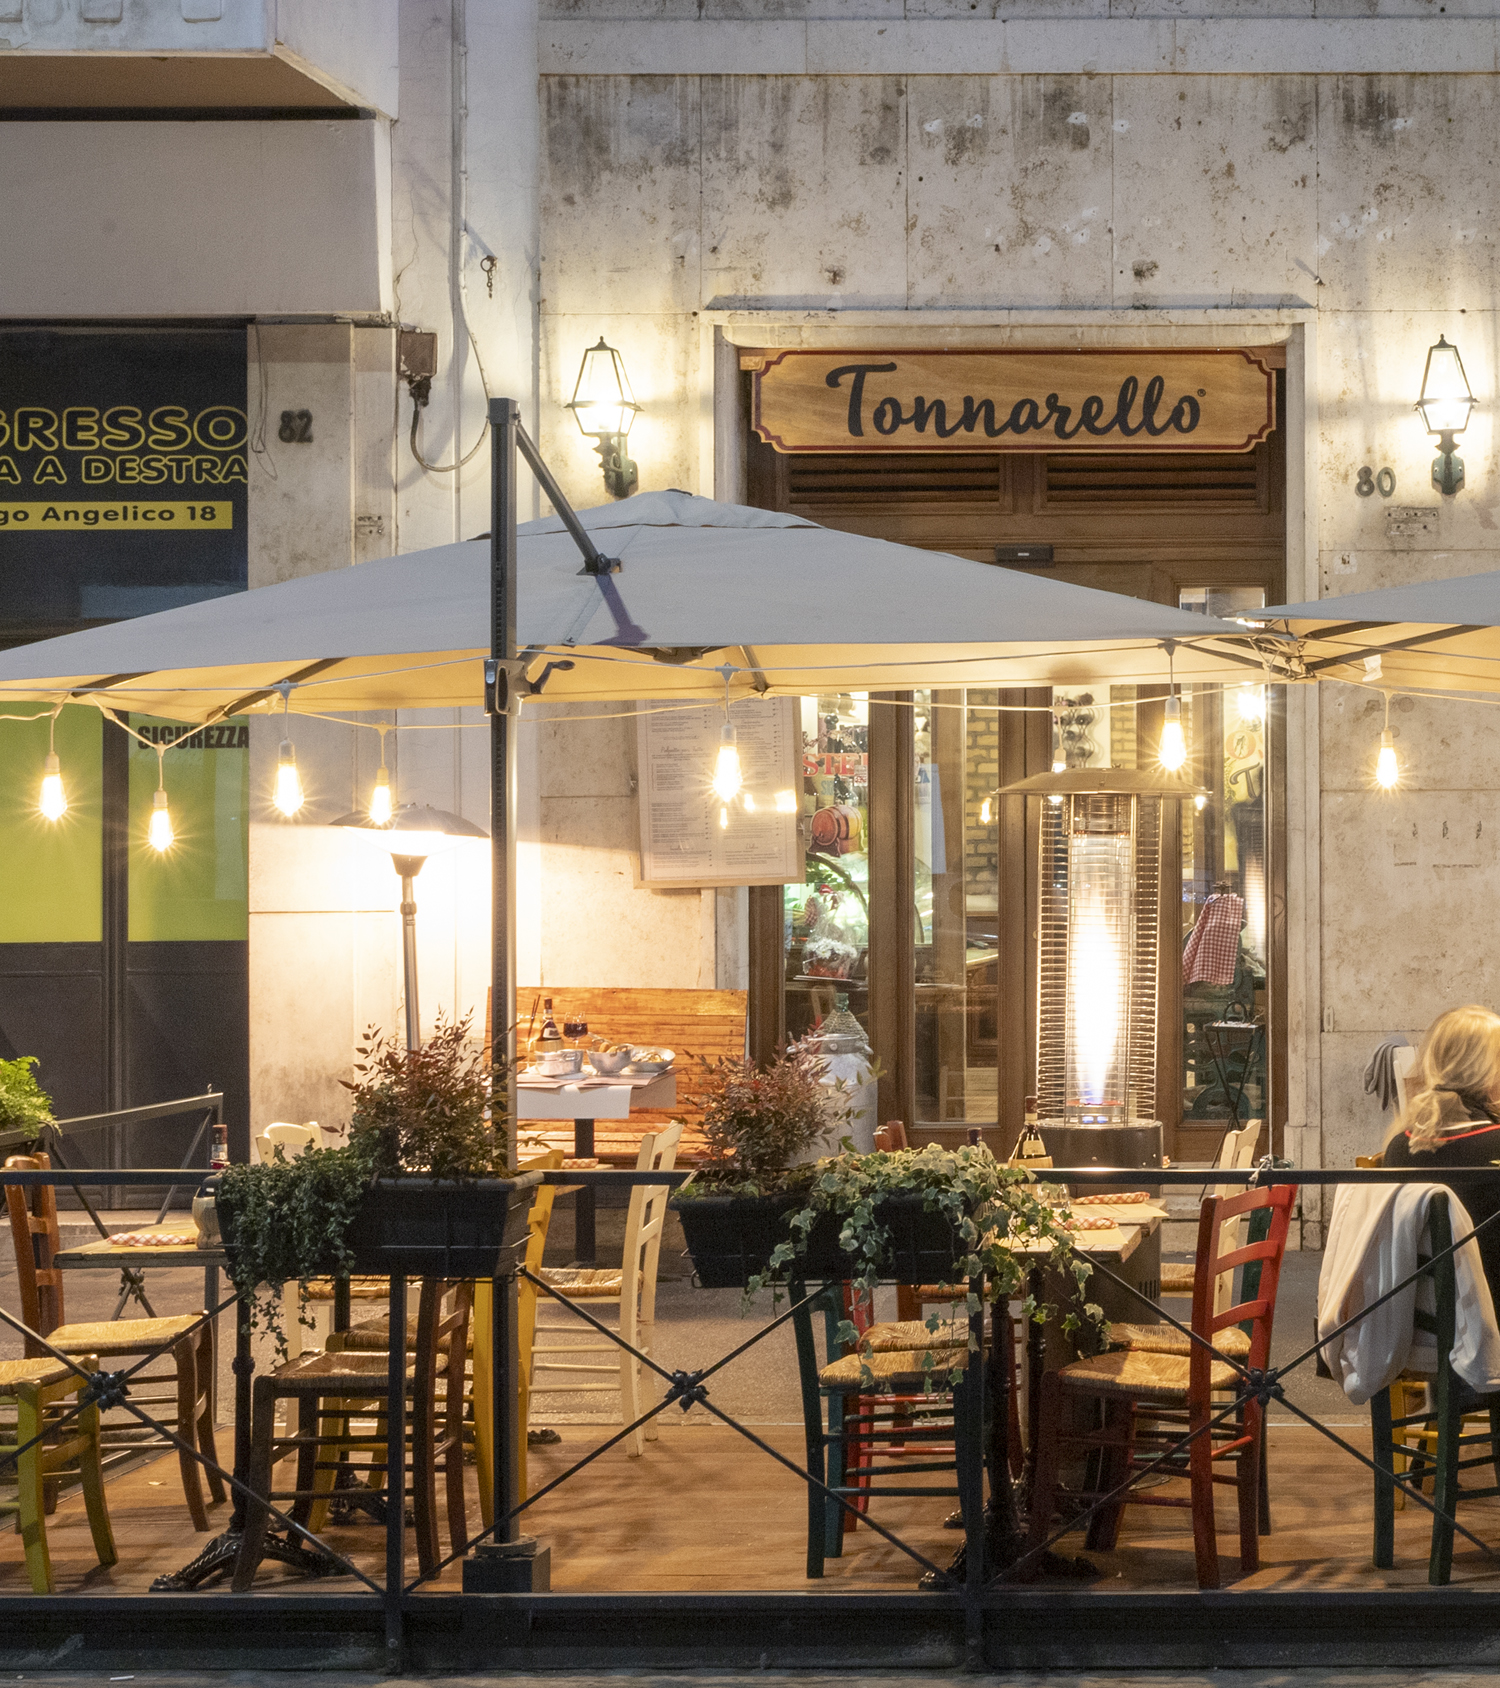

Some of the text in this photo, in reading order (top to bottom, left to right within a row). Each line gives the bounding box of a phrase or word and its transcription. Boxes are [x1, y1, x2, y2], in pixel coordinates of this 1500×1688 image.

[0, 405, 248, 451] RESSO
[278, 408, 314, 443] 82
[33, 455, 67, 484] A
[82, 455, 248, 484] DESTRA
[1356, 465, 1397, 498] 80
[41, 505, 175, 526] Angelico
[187, 505, 216, 521] 18
[138, 725, 249, 750] SICUREZZA
